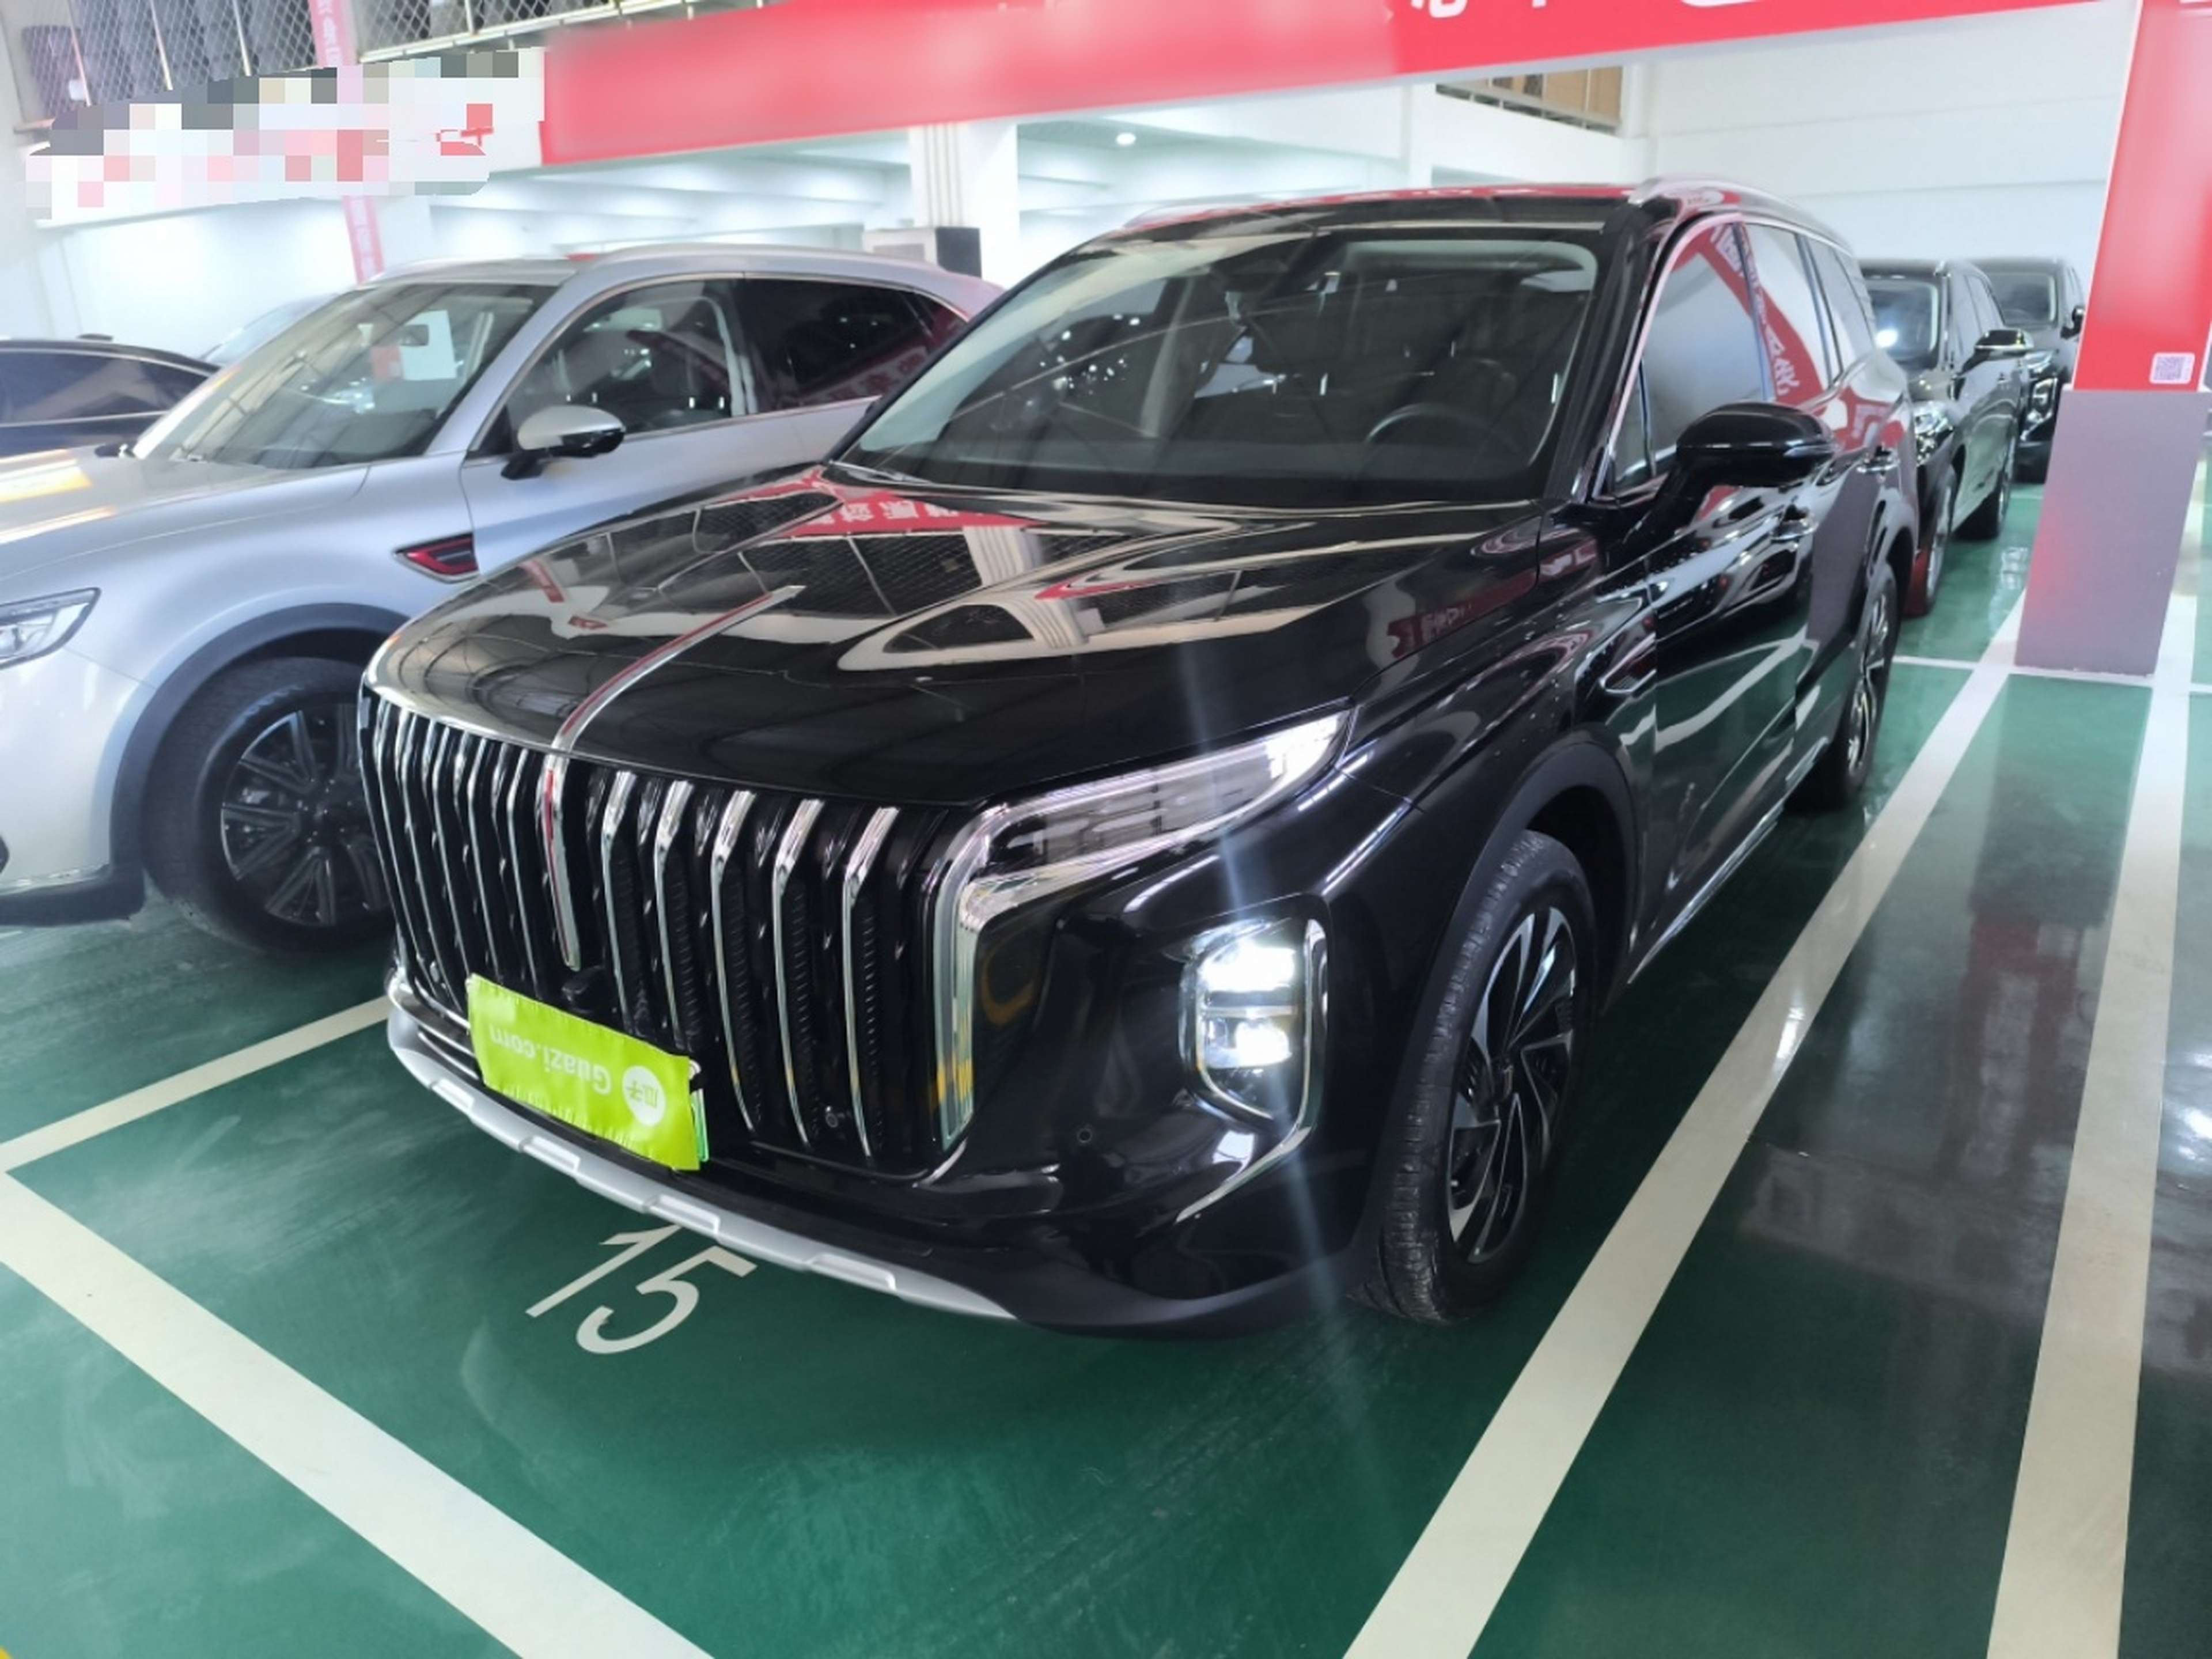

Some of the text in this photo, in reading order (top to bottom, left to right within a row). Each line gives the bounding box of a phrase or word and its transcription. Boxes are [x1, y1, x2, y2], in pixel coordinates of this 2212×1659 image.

[489, 1024, 658, 1109] 瓜子 Guazi.com
[525, 1224, 758, 1354] 15
